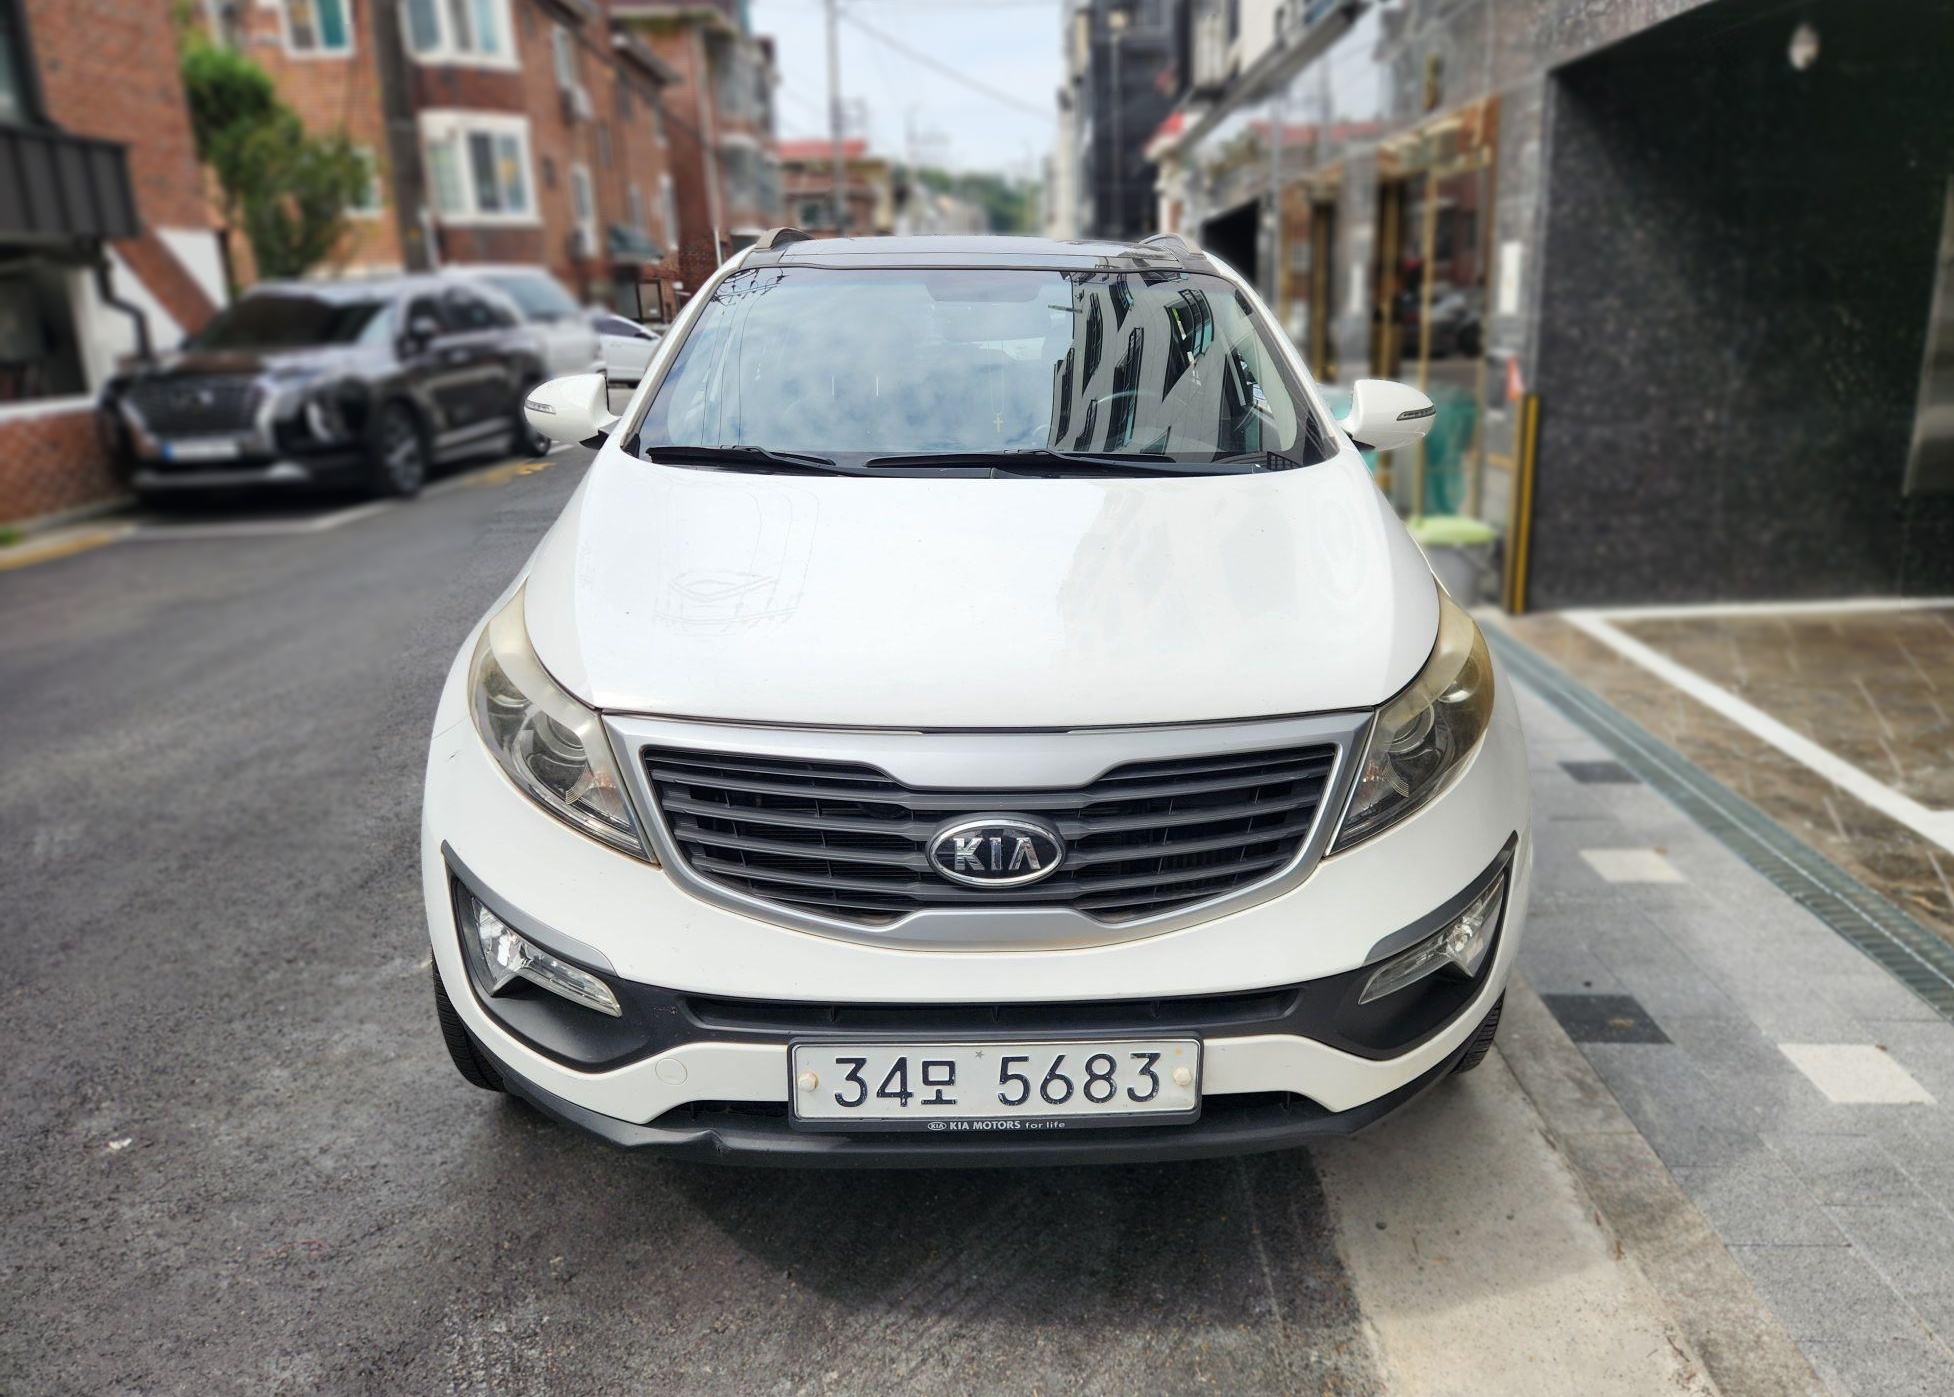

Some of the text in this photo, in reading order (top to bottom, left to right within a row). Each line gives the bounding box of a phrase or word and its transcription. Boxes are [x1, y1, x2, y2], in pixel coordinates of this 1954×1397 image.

[953, 837, 1042, 871] KIA
[834, 1052, 1161, 1108] 34모 5683
[950, 1120, 1066, 1130] KIA MOTORS for life
